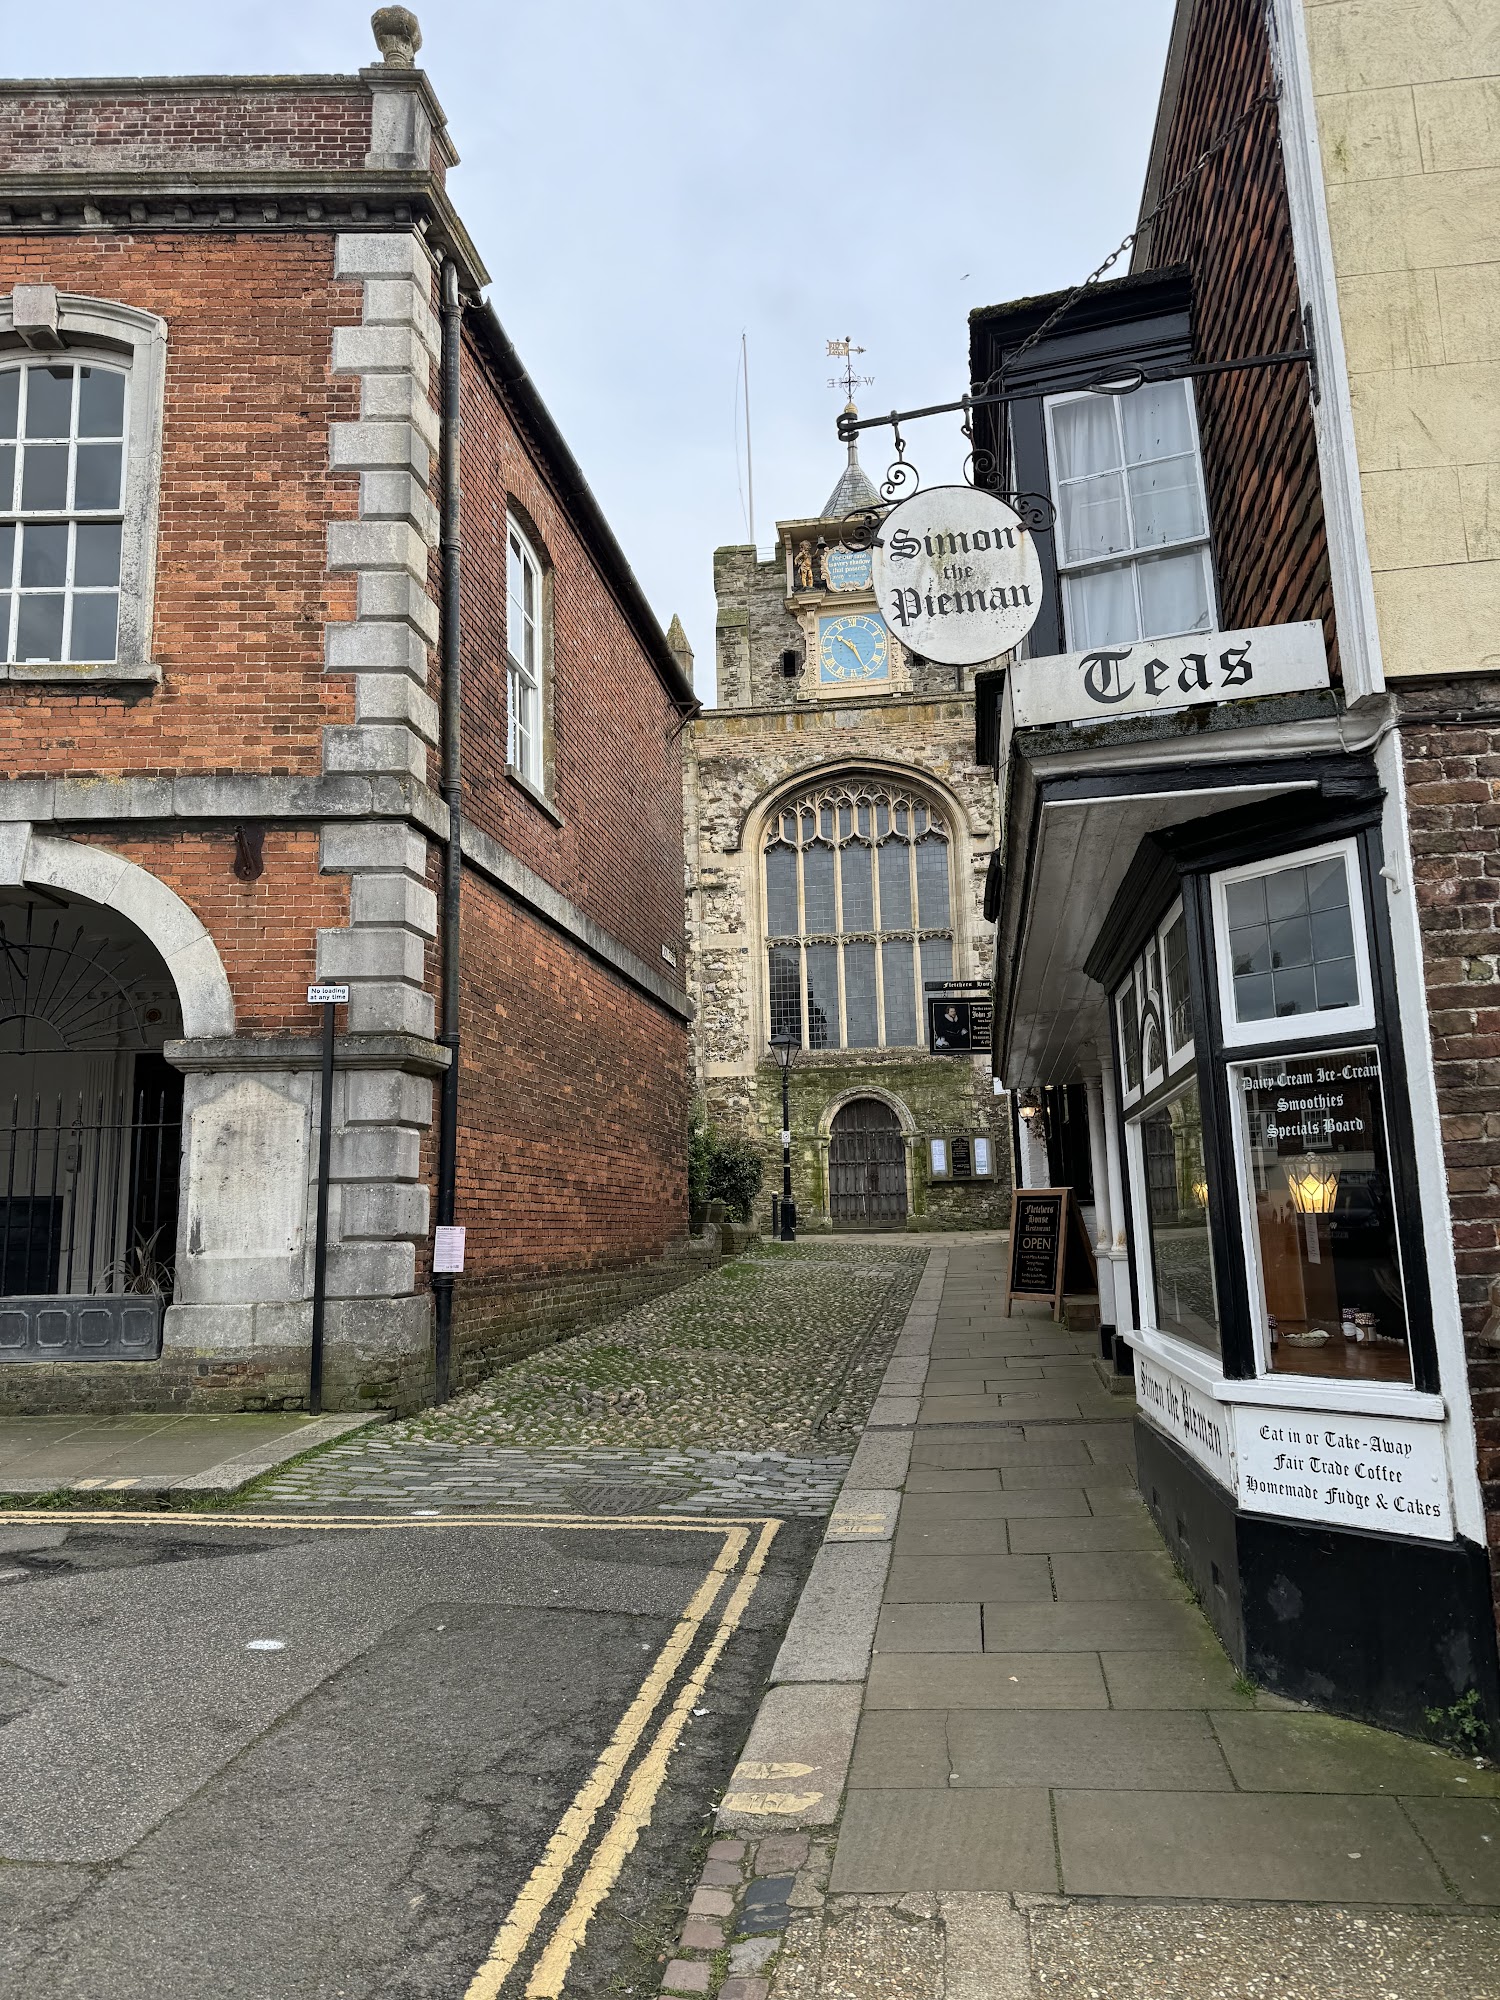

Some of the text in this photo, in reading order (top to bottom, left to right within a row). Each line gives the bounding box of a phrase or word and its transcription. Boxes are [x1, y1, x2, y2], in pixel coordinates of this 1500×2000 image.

[890, 527, 1017, 562] Simon
[944, 564, 973, 581] the
[890, 584, 1034, 627] Pieman
[1078, 640, 1253, 704] Teas
[1241, 1064, 1380, 1091] Dairy Cream Ice-Cream
[1277, 1093, 1344, 1113] Smoothies
[1266, 1117, 1364, 1140] Specials Board
[1025, 1204, 1054, 1214] Fletchers
[1028, 1215, 1048, 1224] House
[1022, 1238, 1051, 1250] OPEN
[1166, 1374, 1180, 1429] the
[1180, 1384, 1222, 1458] Pieman
[1260, 1425, 1412, 1459] Eat in or Take-Away
[1273, 1454, 1402, 1483] Fair Trade Coffee
[1246, 1475, 1441, 1517] Homemade Fudge & Cakes
